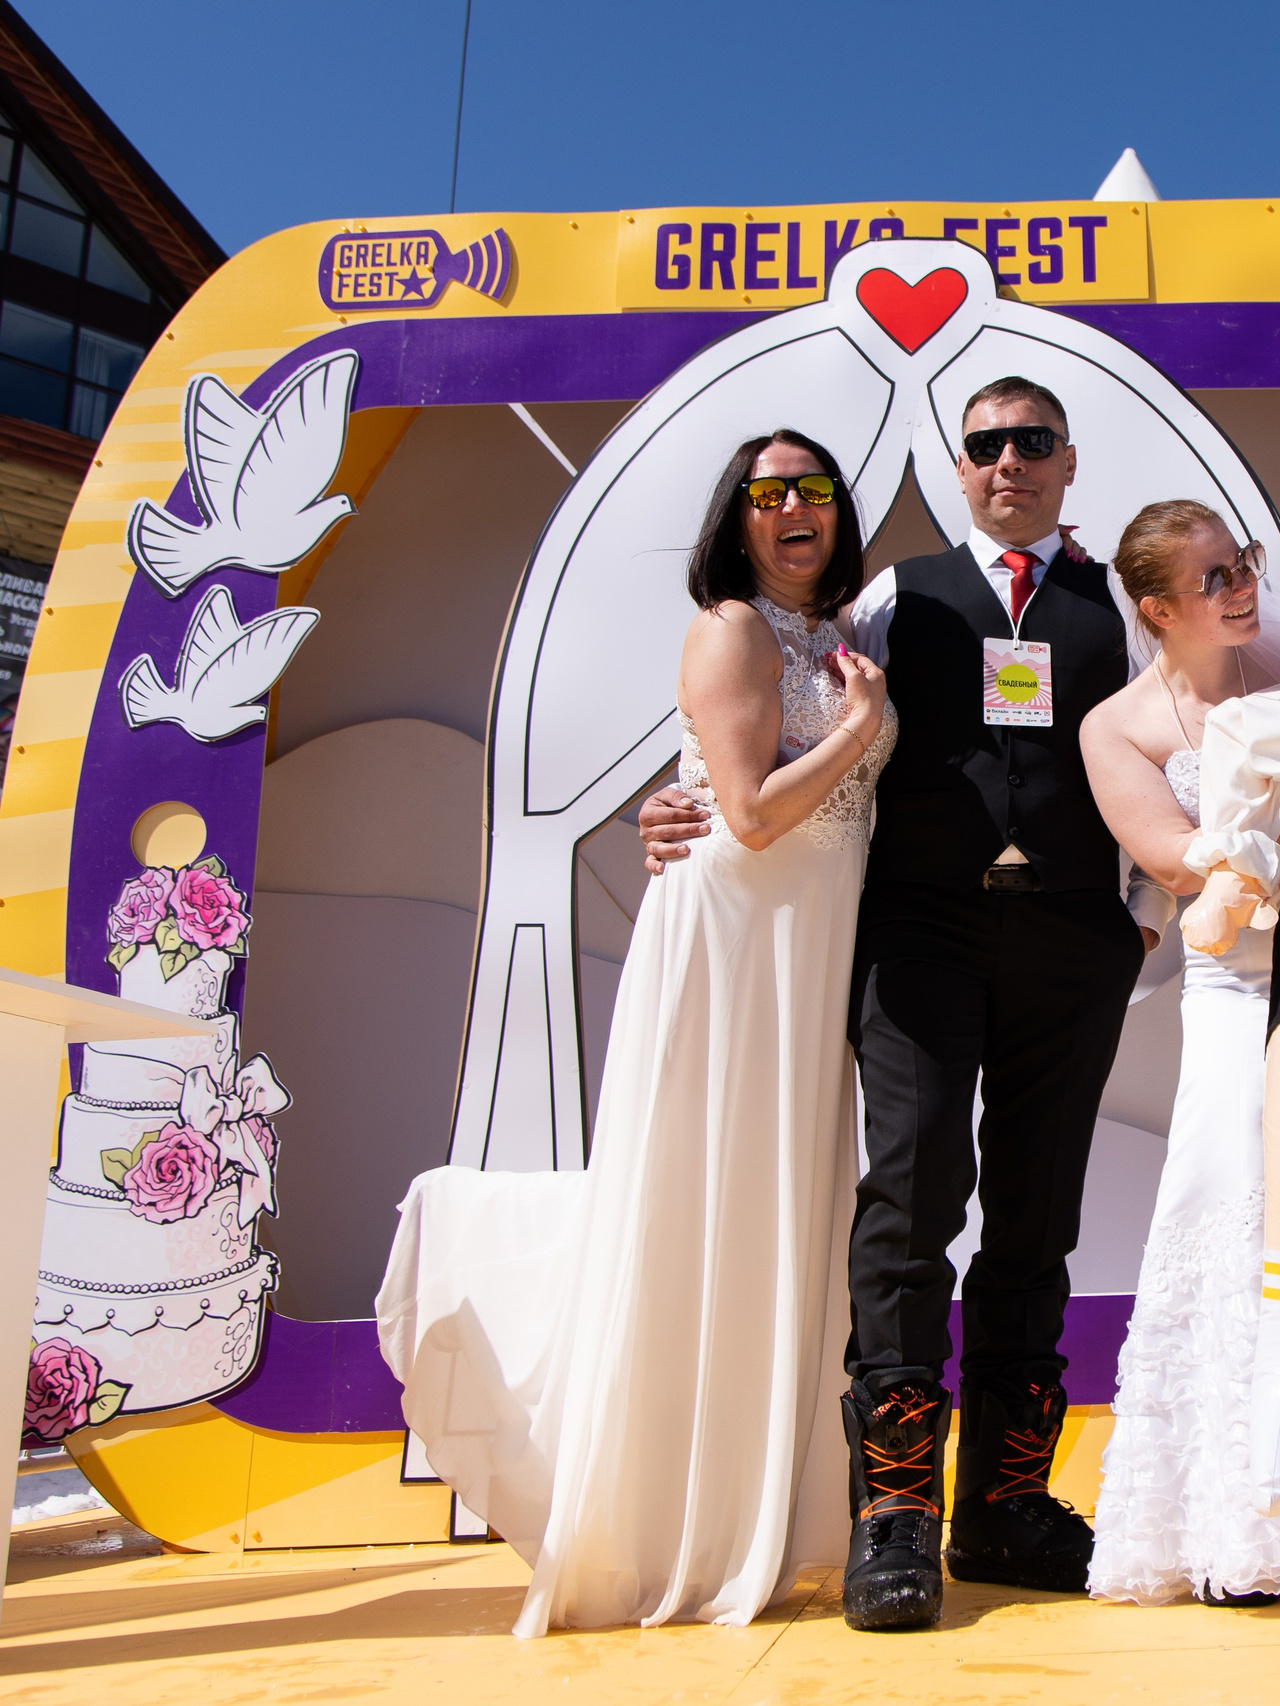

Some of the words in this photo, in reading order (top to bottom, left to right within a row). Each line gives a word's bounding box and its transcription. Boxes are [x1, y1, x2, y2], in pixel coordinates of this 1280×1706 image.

[339, 241, 430, 269] GRELKA
[337, 271, 399, 298] FEST
[998, 679, 1038, 688] СВАДЕБНЫЙ
